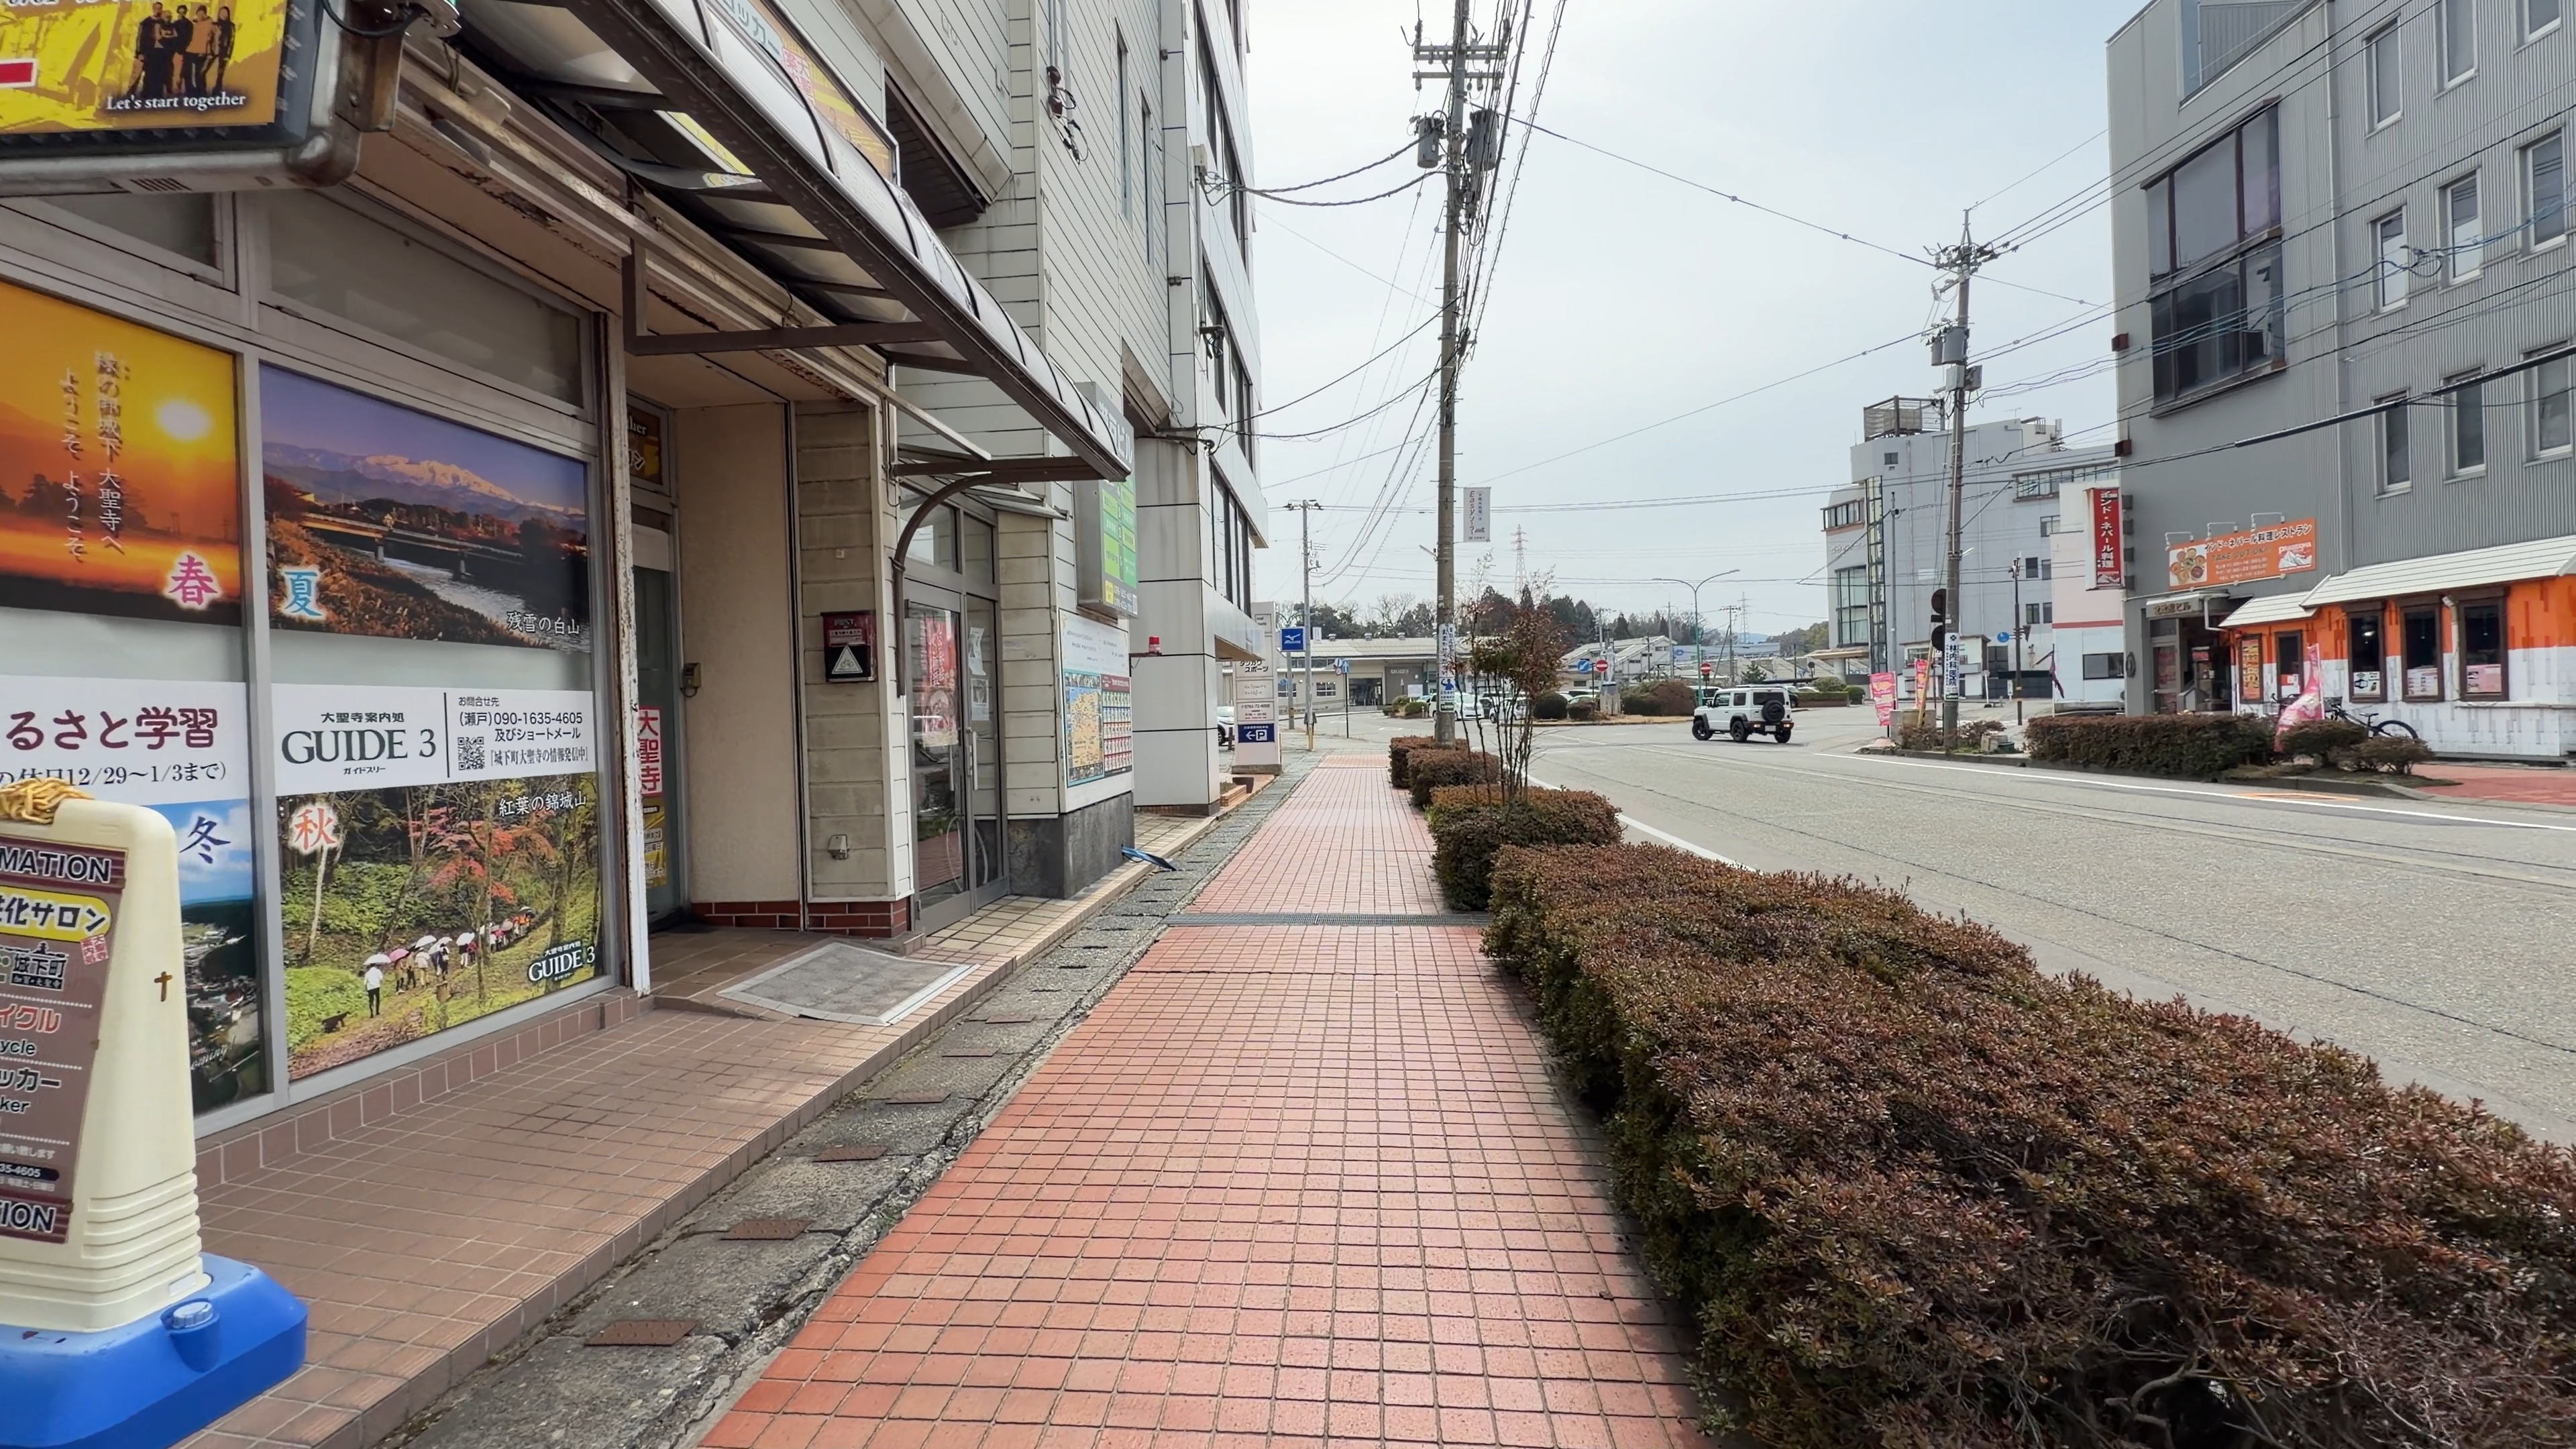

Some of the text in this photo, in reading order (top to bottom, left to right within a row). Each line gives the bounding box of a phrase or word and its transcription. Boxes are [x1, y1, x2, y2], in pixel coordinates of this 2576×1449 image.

[106, 92, 246, 111] Let's start together
[62, 470, 81, 557] ようこそ
[168, 554, 218, 606] 春
[284, 570, 323, 617] 夏
[506, 610, 580, 635] 残雪の白山
[320, 712, 405, 723] 大聖寺案内処
[458, 696, 500, 707] お問合せ先
[6, 706, 218, 751] るさと学習
[495, 727, 582, 743] 及びショートメール
[281, 729, 437, 764] GUIDE 3
[638, 710, 661, 792] 大聖寺
[343, 766, 387, 775] ガイドスリー
[498, 790, 586, 817] 紅葉の錦城山
[179, 815, 231, 865] 冬
[293, 808, 334, 851] 秋
[13, 953, 68, 978] 城下町
[528, 946, 596, 982] GUIDE 3
[0, 1199, 57, 1234] ION
